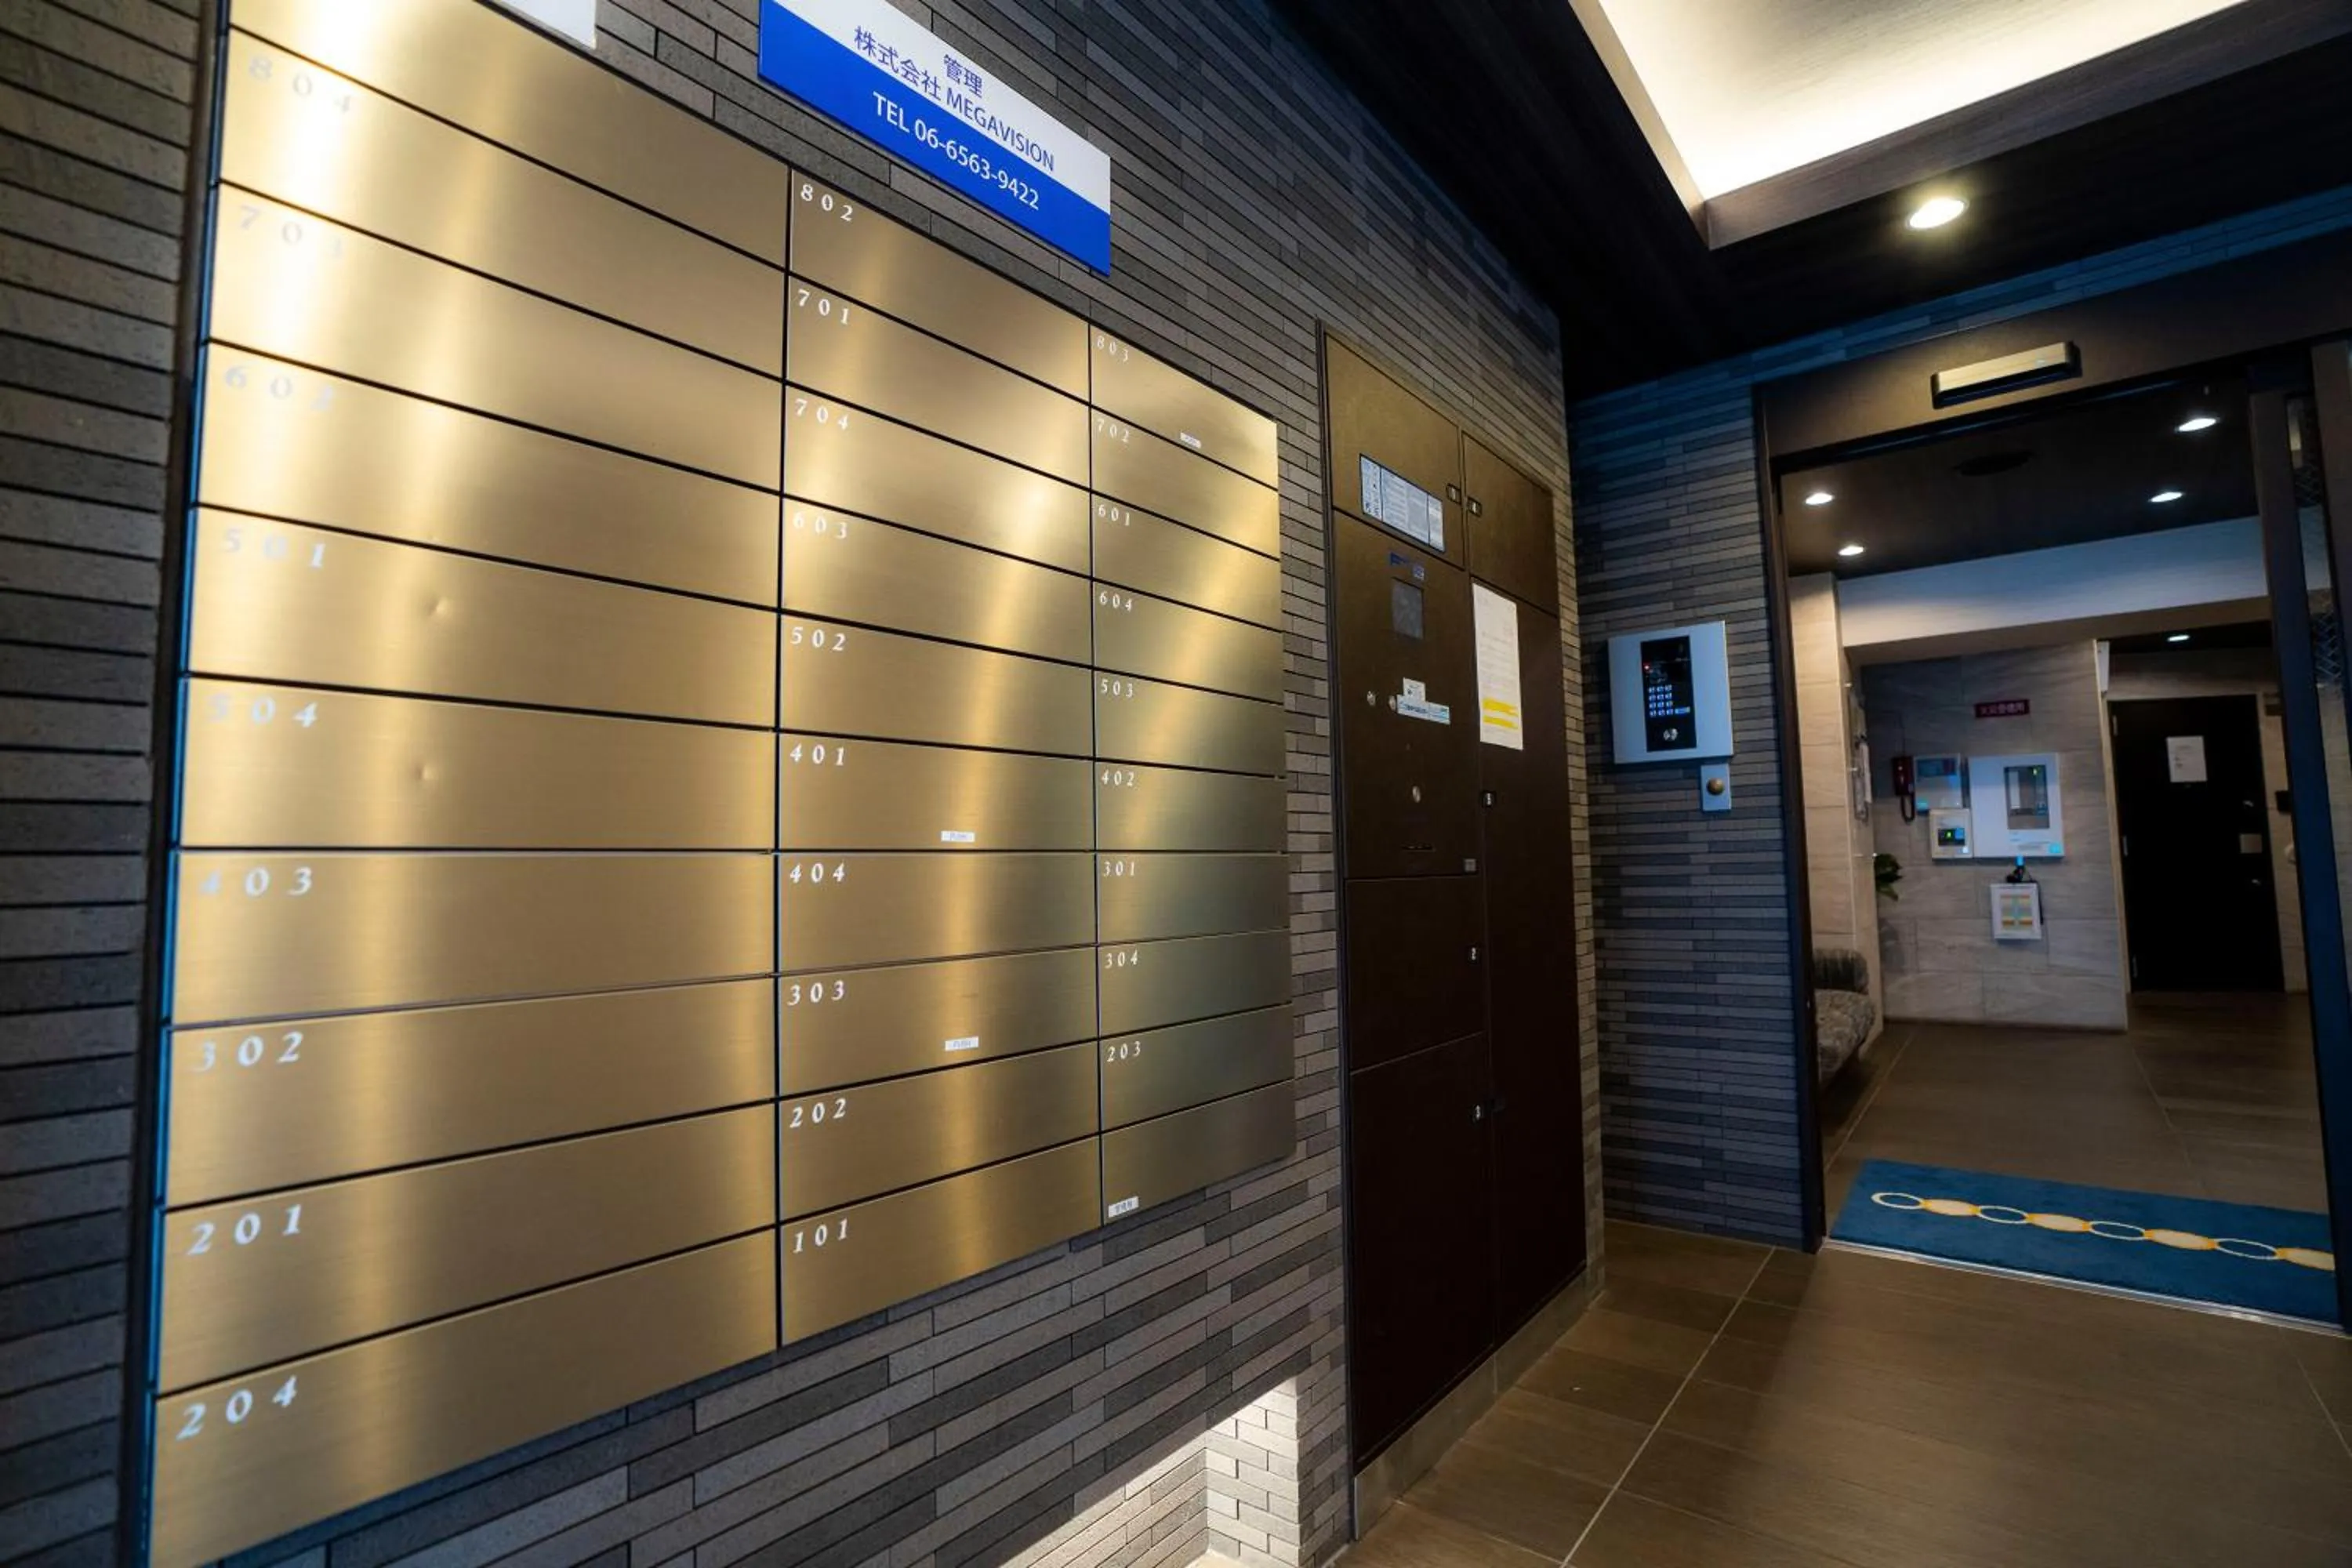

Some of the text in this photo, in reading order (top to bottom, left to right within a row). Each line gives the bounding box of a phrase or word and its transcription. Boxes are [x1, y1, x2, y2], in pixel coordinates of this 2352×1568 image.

[943, 53, 982, 99] 管理
[854, 25, 1054, 172] 株式会社 MEGAVISION
[873, 92, 1040, 211] TEL 06-6563-9422
[800, 184, 853, 221] 802
[797, 289, 849, 325] 701
[1097, 335, 1129, 364] 803
[794, 398, 849, 430] 704
[1098, 419, 1129, 443] 702
[793, 510, 848, 539] 603
[1098, 504, 1130, 526] 601
[1099, 593, 1133, 612] 604
[790, 626, 847, 651] 502
[1100, 678, 1133, 698] 503
[790, 743, 844, 766] 401
[1101, 769, 1134, 787] 402
[200, 867, 313, 897] 403
[789, 862, 845, 884] 404
[1103, 861, 1135, 877] 301
[1105, 950, 1138, 969] 304
[787, 980, 845, 1006] 303
[191, 1032, 303, 1072] 302
[1106, 1041, 1141, 1062] 203
[789, 1098, 846, 1128] 202
[186, 1204, 302, 1256] 201
[793, 1218, 848, 1254] 101
[176, 1375, 297, 1441] 204
